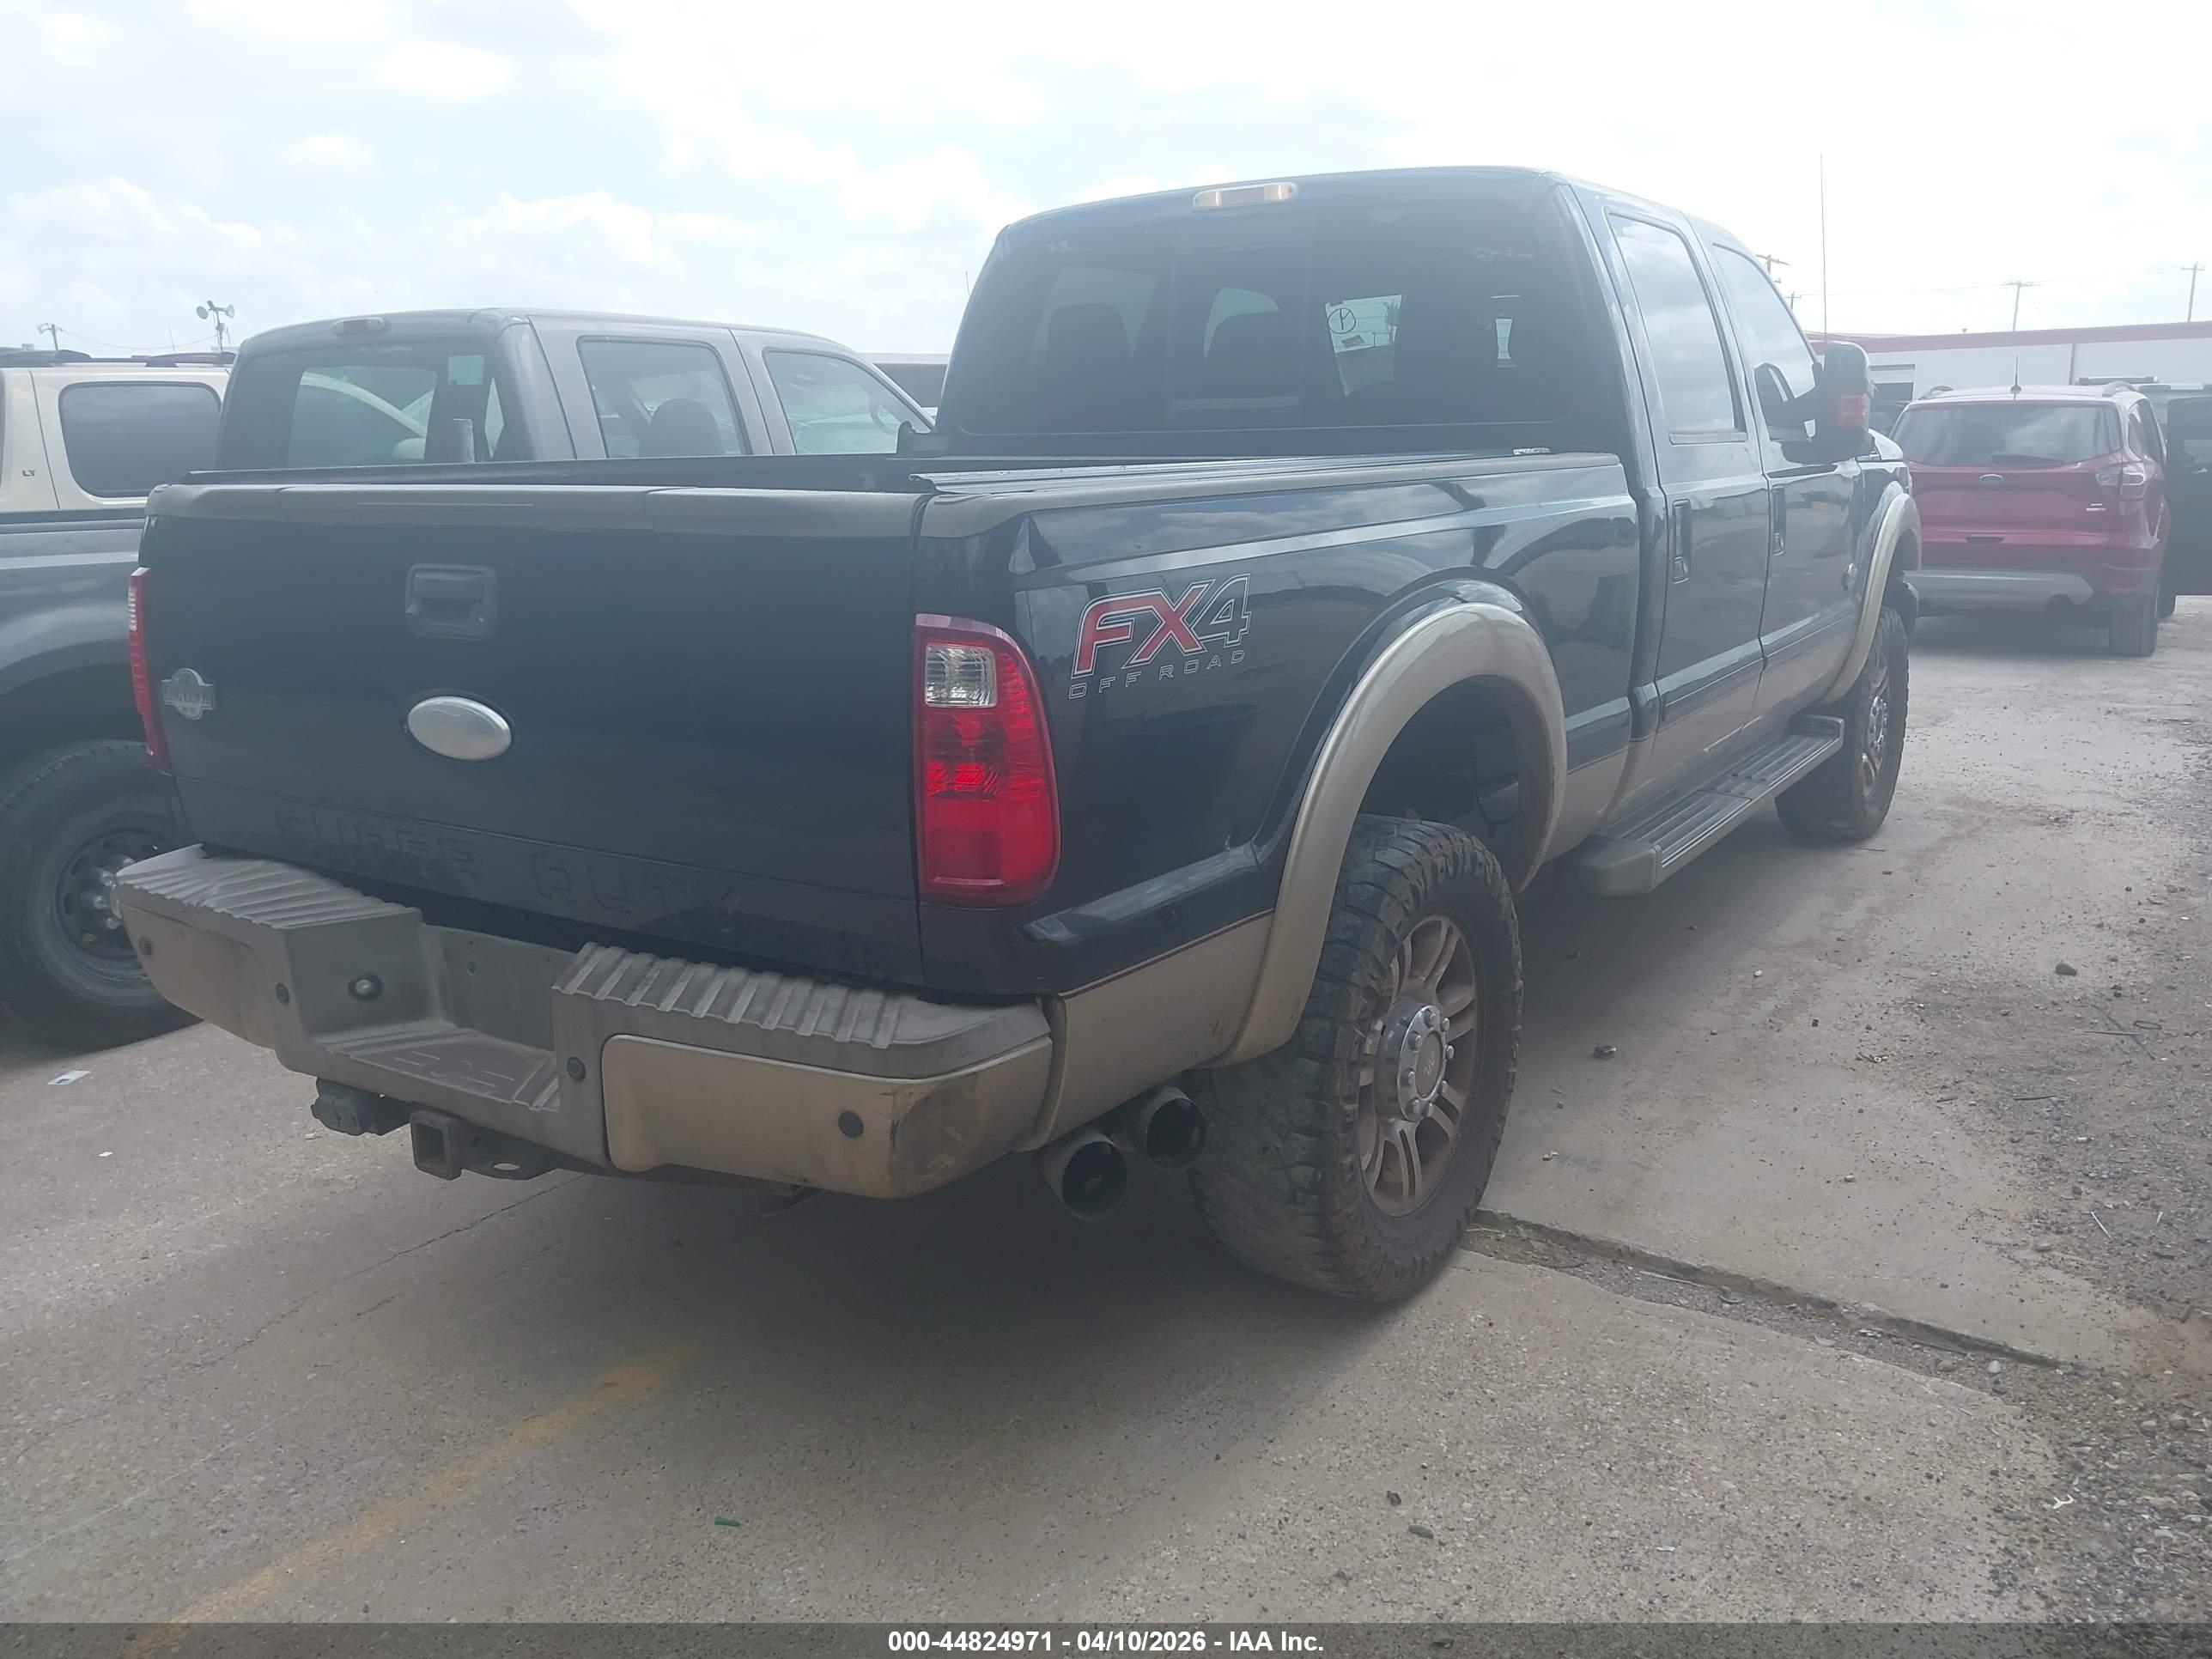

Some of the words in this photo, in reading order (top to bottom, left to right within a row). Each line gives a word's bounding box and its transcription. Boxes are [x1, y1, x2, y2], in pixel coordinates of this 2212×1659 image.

[1071, 573, 1251, 679] FX4
[1068, 671, 1142, 700] OFF
[1158, 649, 1246, 681] ROAD
[530, 849, 744, 934] DUTY
